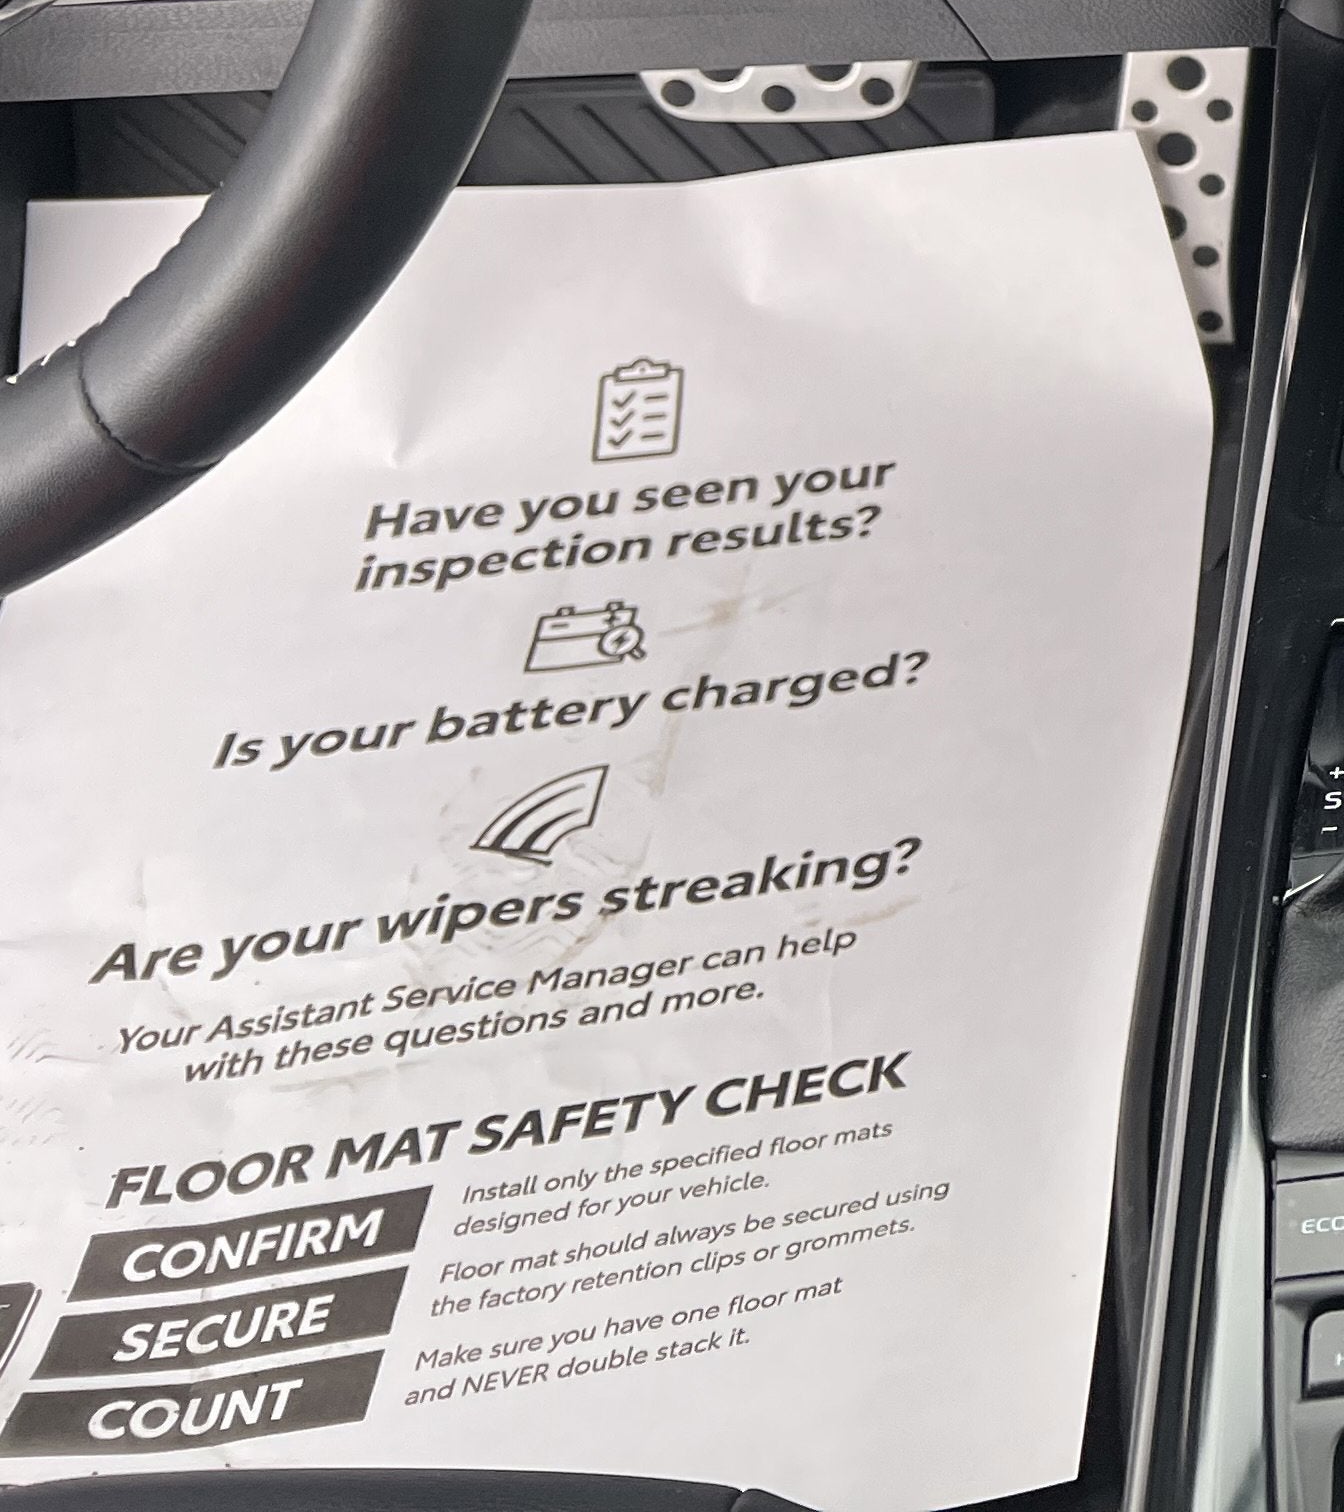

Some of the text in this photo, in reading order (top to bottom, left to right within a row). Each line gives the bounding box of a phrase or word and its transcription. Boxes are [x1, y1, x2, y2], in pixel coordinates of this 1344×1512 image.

[365, 462, 897, 540] Have you seen your
[355, 504, 882, 592] inspection results?
[213, 650, 930, 772] Is your battery charged?
[1323, 791, 1342, 810] S
[87, 836, 923, 984] Are your wipers streaking?
[119, 927, 857, 1055] Your Assistant Service Manager can help
[105, 1050, 912, 1210] FLOOR MAT SAFETY CHECK
[462, 1122, 893, 1205] Install only the specified floor mats
[122, 1208, 385, 1282] CONFIRM
[430, 1219, 915, 1317] the factory retention clips or grommets.
[439, 1182, 951, 1284] Floor mat should always be secured using
[112, 1293, 335, 1362] SECURE
[404, 1327, 750, 1406] and NEVER double stack it.
[415, 1276, 843, 1372] Make sure you have one floor mat
[88, 1378, 304, 1440] COUNT
